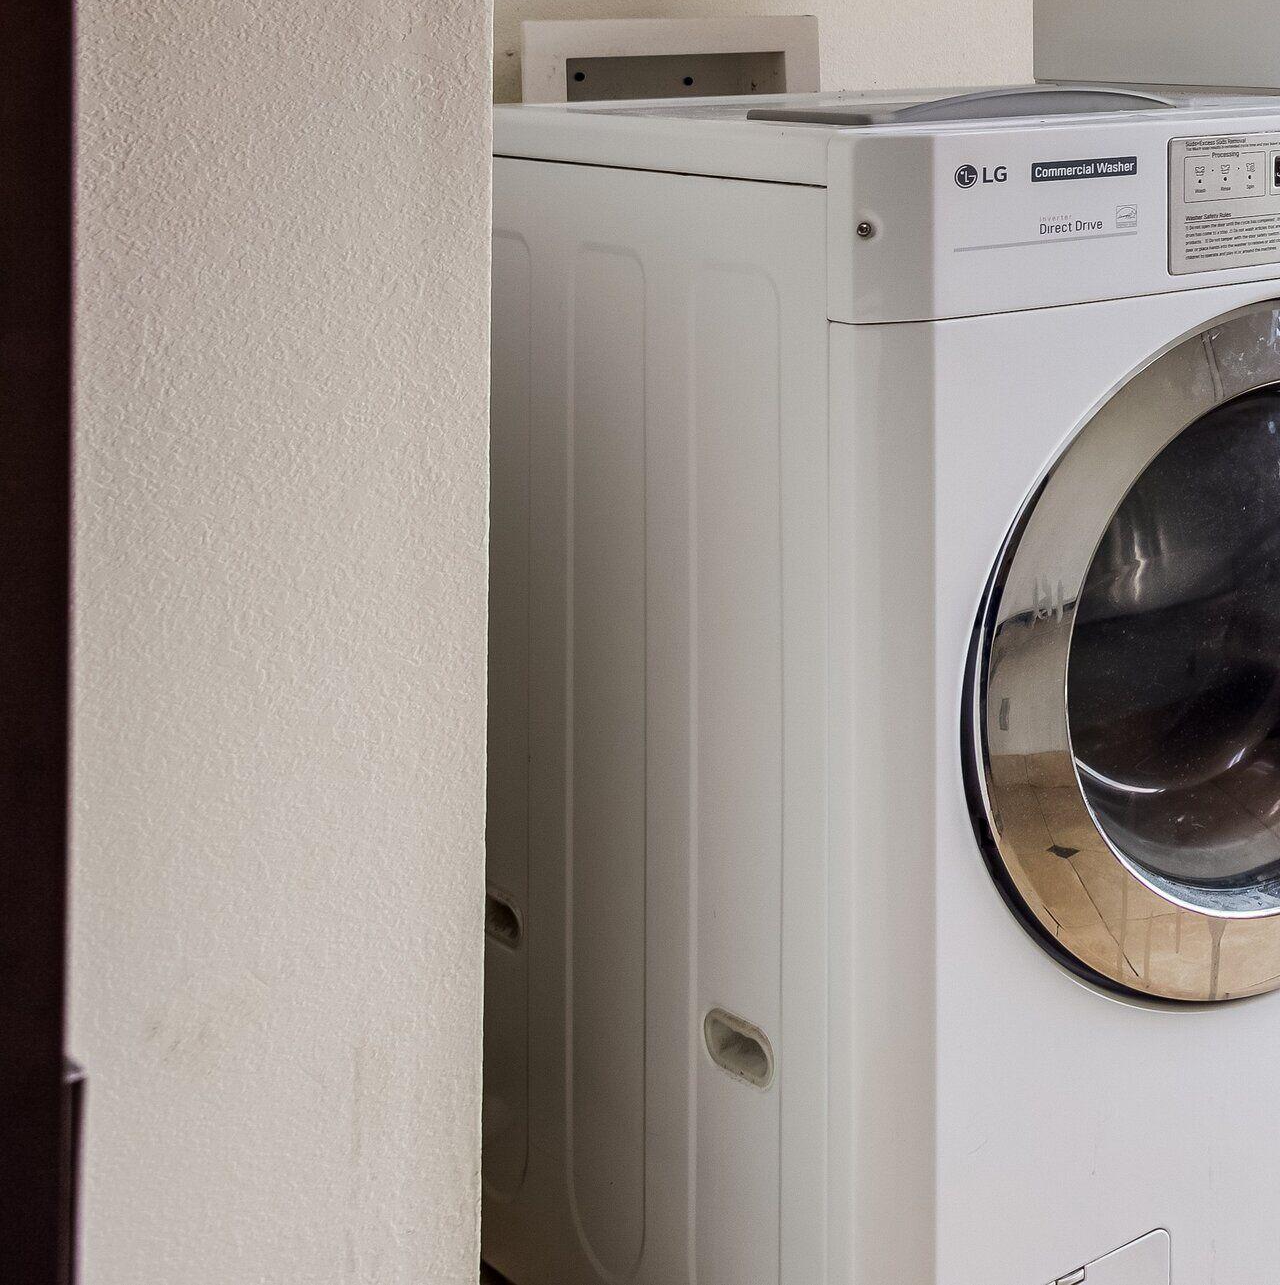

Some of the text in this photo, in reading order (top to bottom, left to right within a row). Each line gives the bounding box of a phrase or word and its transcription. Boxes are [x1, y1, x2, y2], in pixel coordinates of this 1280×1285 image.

[982, 166, 1008, 184] LG
[1034, 160, 1135, 178] Commercial Washer
[1039, 221, 1073, 235] Direct
[1075, 219, 1103, 232] Drive
